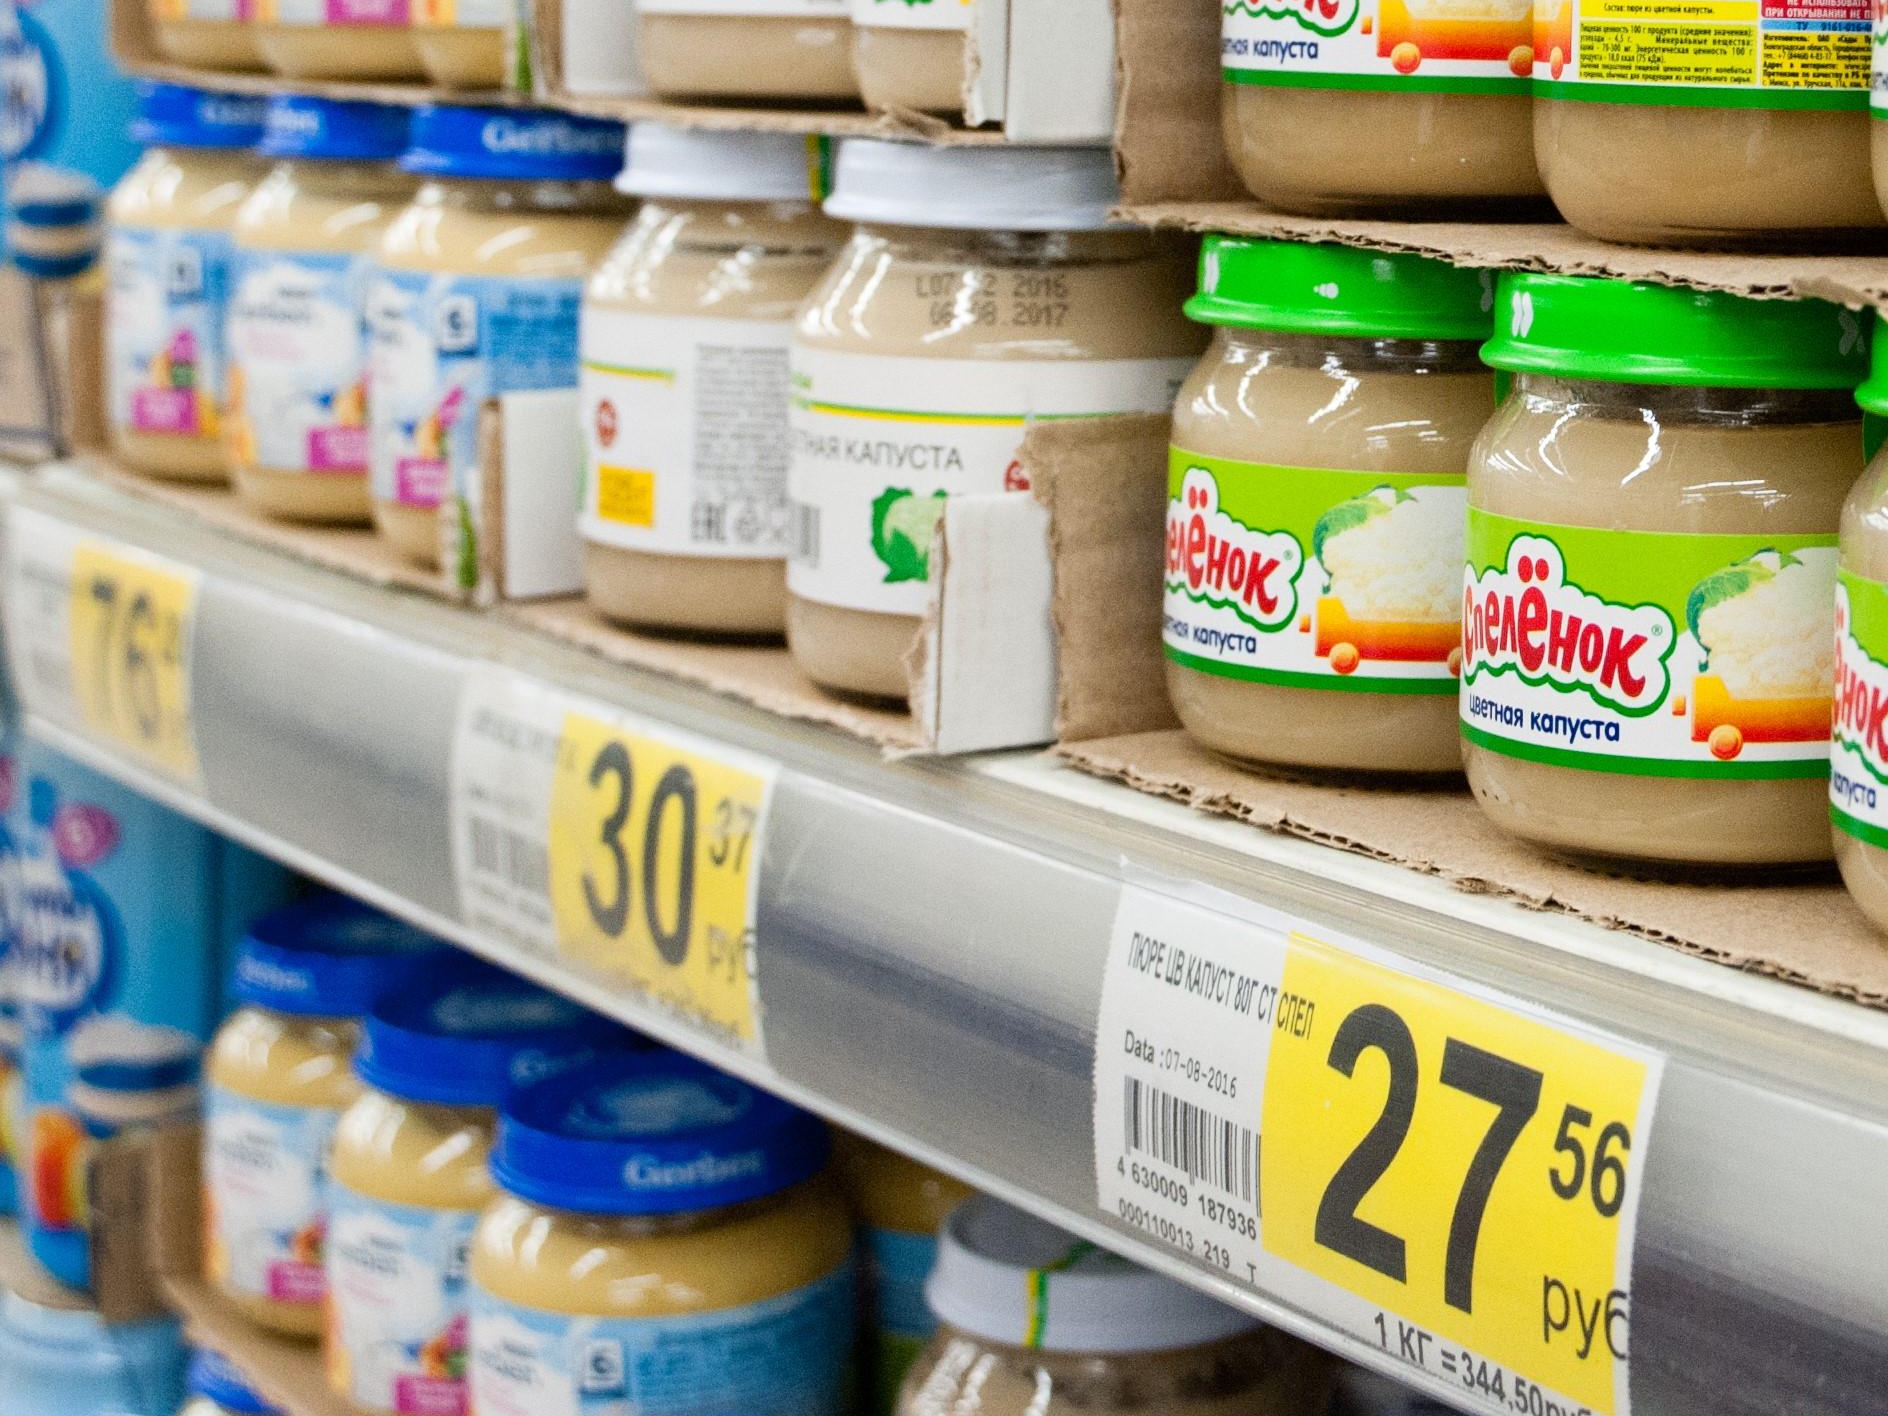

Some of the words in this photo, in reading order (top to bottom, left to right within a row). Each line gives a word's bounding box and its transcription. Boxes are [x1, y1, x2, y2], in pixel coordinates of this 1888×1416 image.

[1765, 8, 1783, 17] ПРИ
[1787, 8, 1846, 17] ОТКРЫВАНИИ
[1850, 9, 1860, 17] НЕ
[1253, 40, 1318, 63] капуста
[845, 438, 964, 471] КАПУСТА
[1166, 486, 1280, 615] елёнок
[1193, 627, 1257, 654] капуста
[1465, 556, 1649, 698] Спелёнок
[1470, 693, 1524, 728] цветная
[1531, 713, 1620, 744] капуста
[582, 742, 698, 967] 30
[709, 797, 757, 873] 37
[1128, 932, 1166, 979] ПЮРЕ
[1165, 946, 1185, 986] ЦВ
[1185, 954, 1235, 1006] КАПУСТ
[1234, 975, 1258, 1016] 80Г
[1258, 984, 1277, 1024] СТ
[1277, 992, 1315, 1040] СПЕЛ
[1124, 1030, 1155, 1064] Data
[1313, 1002, 1545, 1315] 27
[1549, 1103, 1632, 1218] 56
[1116, 1156, 1126, 1177] 4
[1131, 1168, 1188, 1206] 630009
[1199, 1194, 1256, 1240] 187936
[1119, 1198, 1194, 1251] 000110013
[1204, 1240, 1230, 1269] 219
[1374, 1312, 1386, 1348] 1
[1398, 1320, 1432, 1366] КГ
